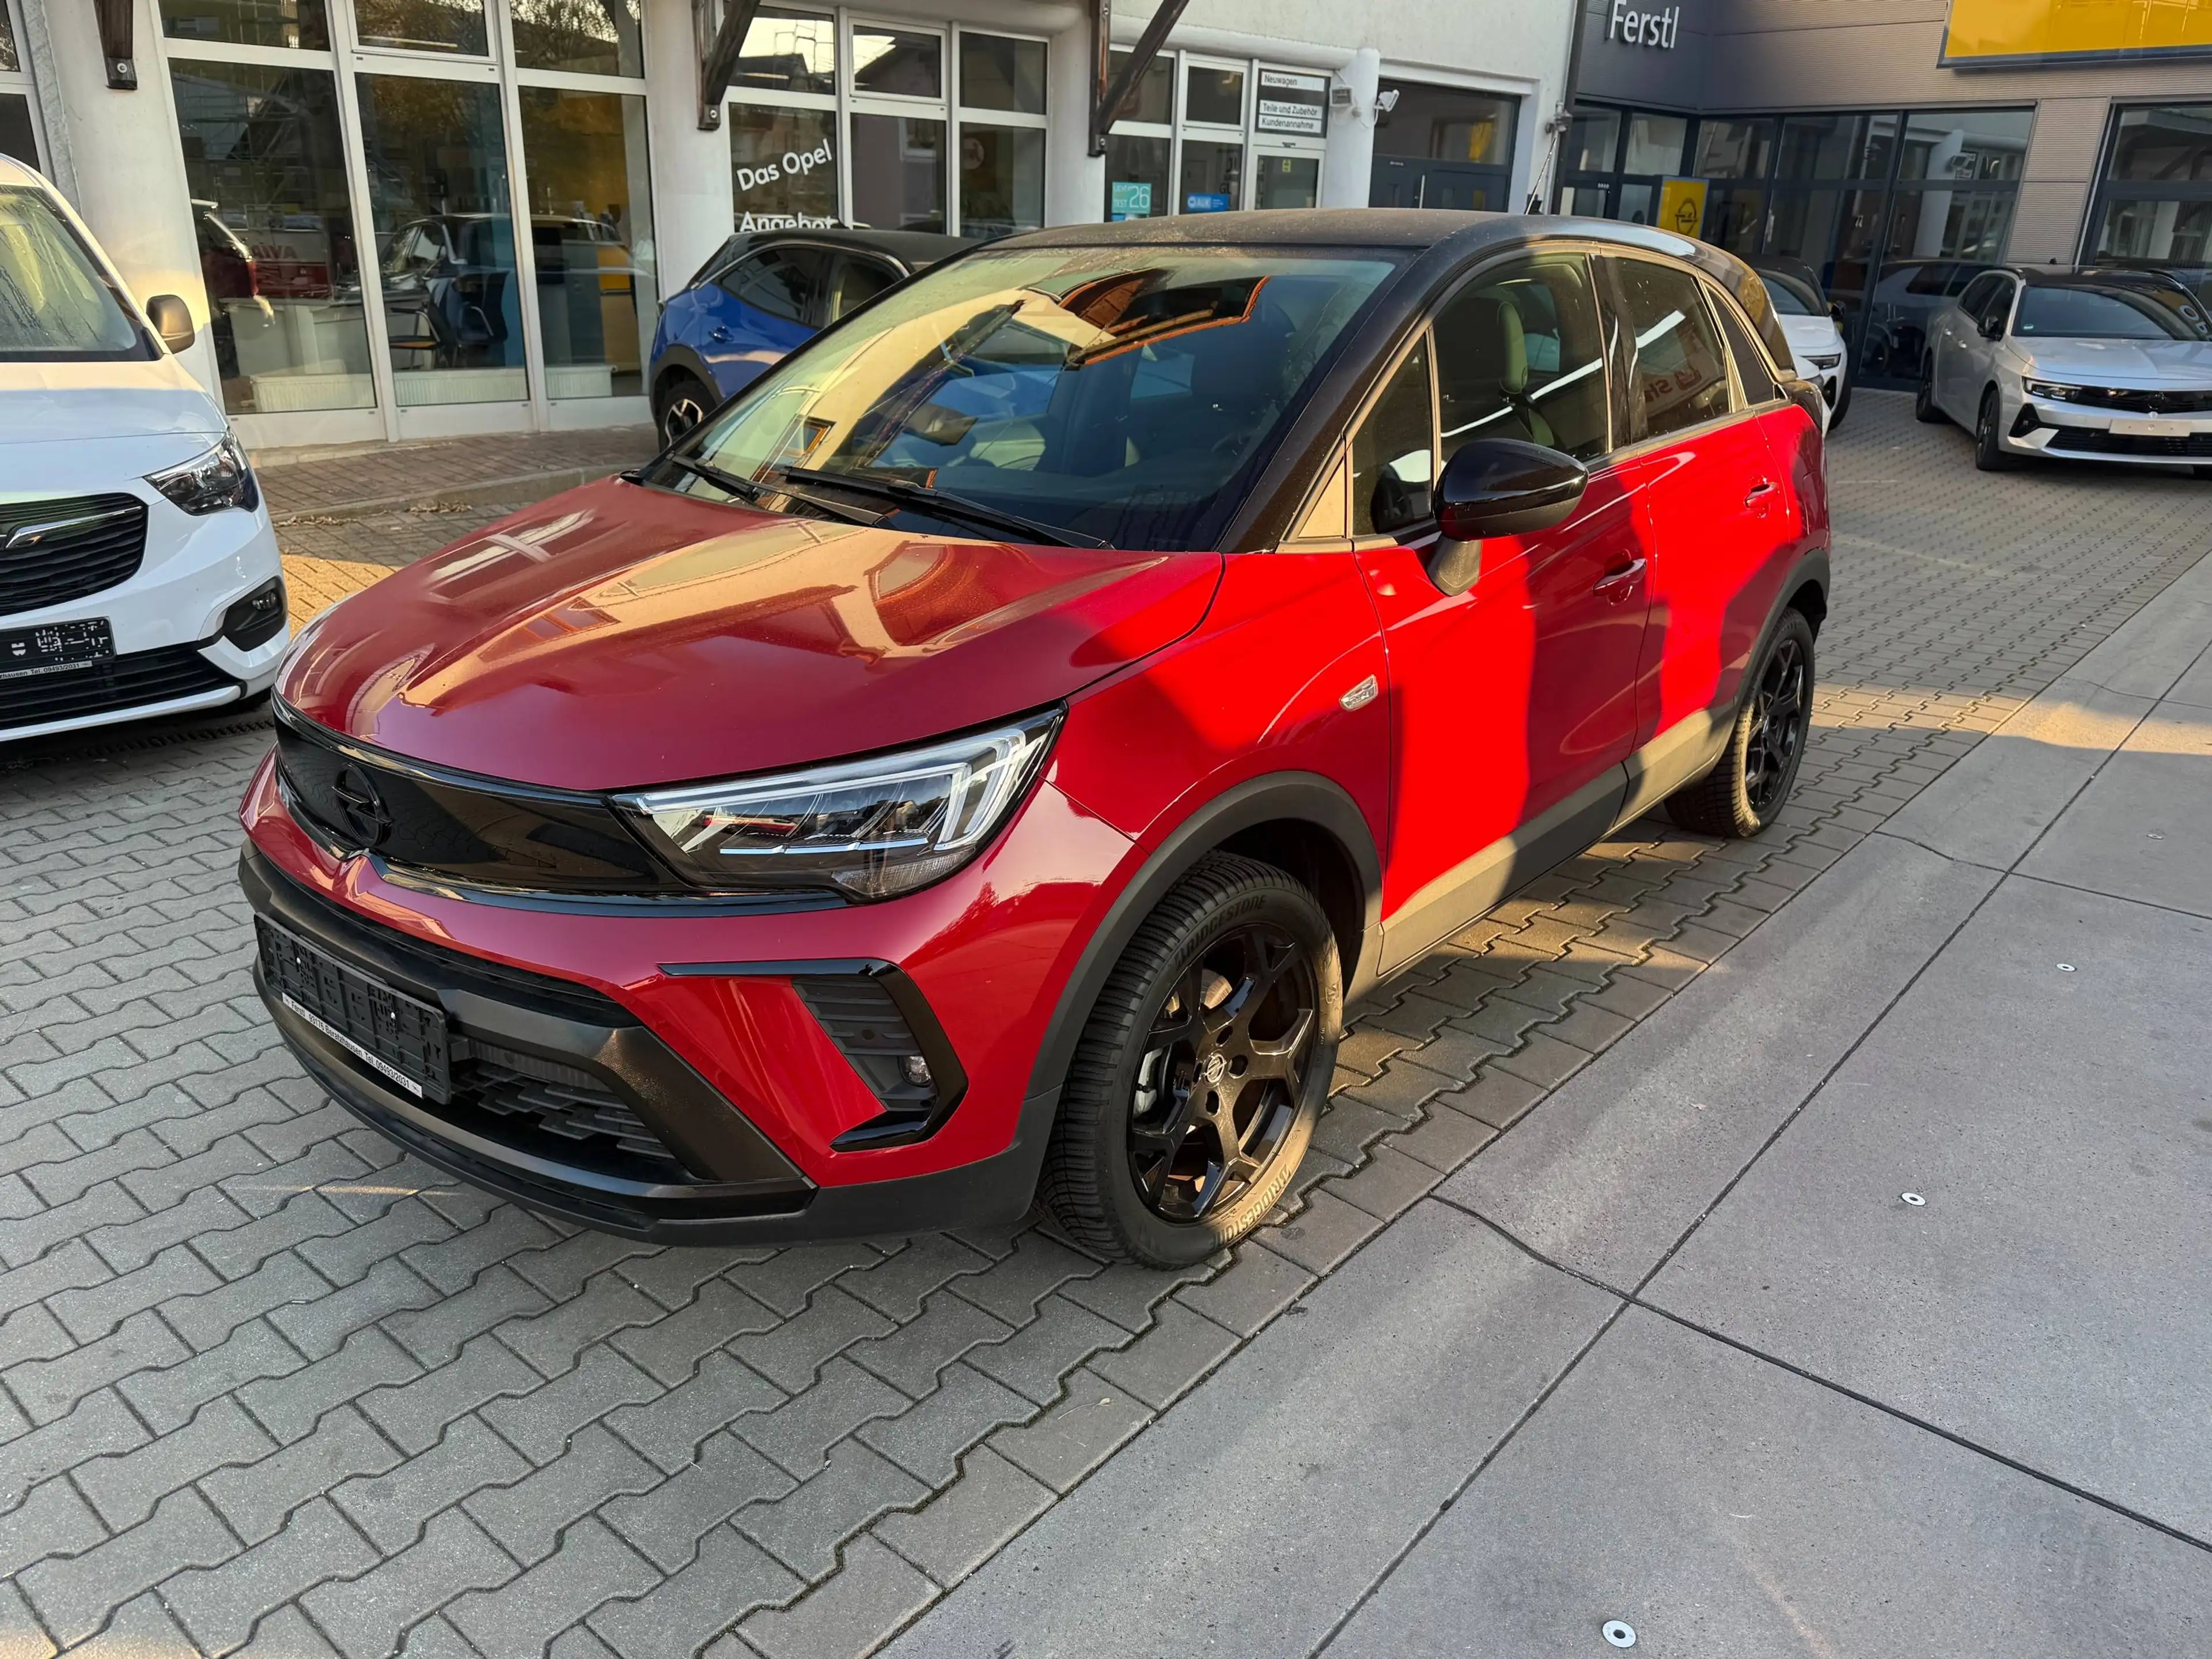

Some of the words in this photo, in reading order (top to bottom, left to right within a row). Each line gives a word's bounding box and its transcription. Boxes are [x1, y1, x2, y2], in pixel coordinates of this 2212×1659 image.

[1609, 0, 1679, 48] Ferstl
[1264, 74, 1297, 88] Neuwagen
[1263, 103, 1278, 112] Teile
[1279, 105, 1291, 113] und
[1292, 105, 1318, 115] Zubehör
[1261, 117, 1314, 129] Kundenannahme
[736, 164, 780, 191] Das
[782, 138, 832, 175] Opel
[1128, 185, 1150, 208] 26
[43, 663, 79, 673] 09493/2031
[1174, 894, 1267, 972] BRIDGESTONE
[291, 1001, 305, 1017] Ferstl
[325, 1025, 362, 1058] Beratzhausen
[364, 1051, 376, 1066] Tel.
[376, 1060, 410, 1088] 09493/2031
